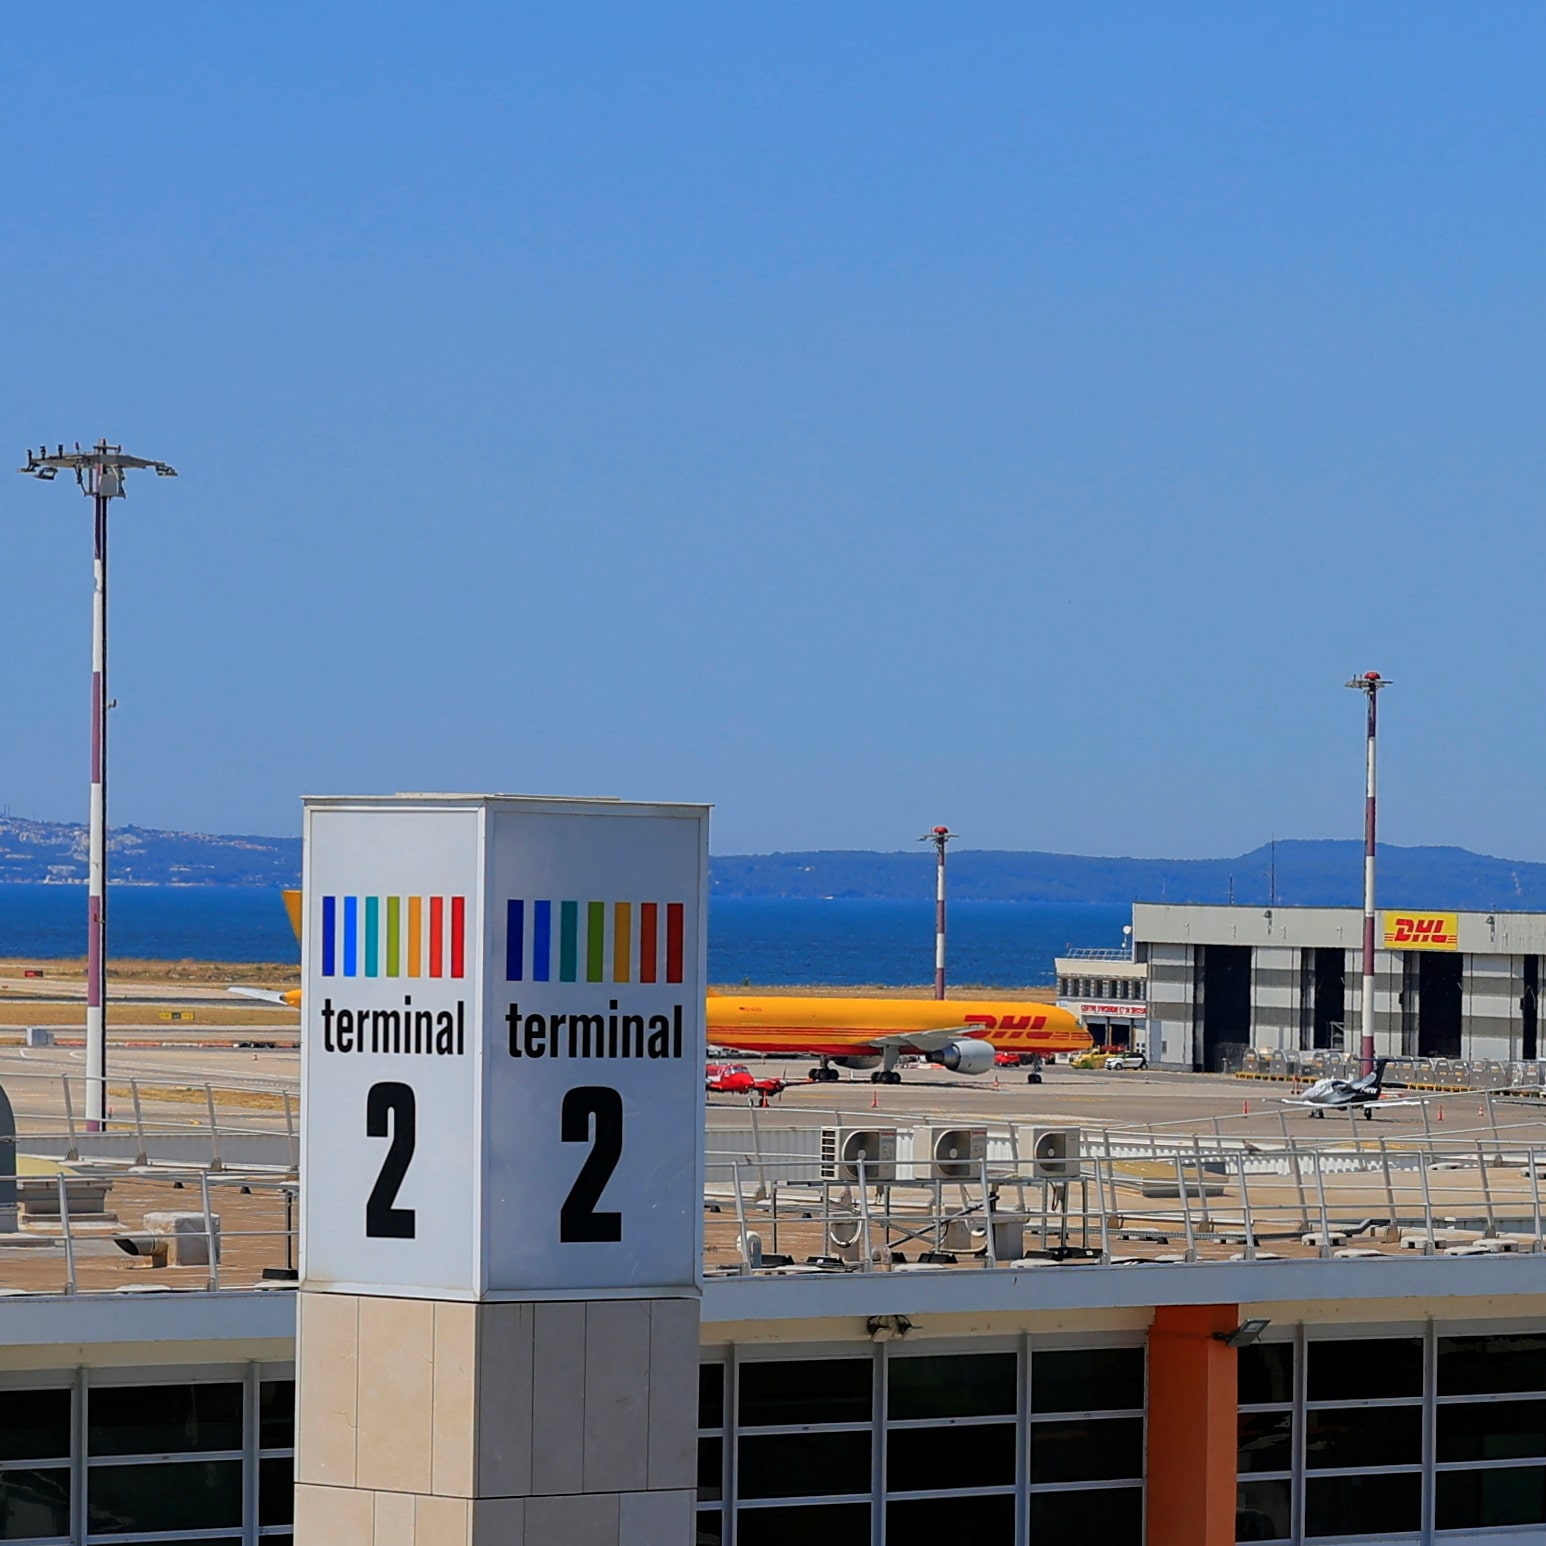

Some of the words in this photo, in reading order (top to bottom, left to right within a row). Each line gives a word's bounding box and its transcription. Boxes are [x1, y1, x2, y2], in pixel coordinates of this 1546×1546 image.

[1394, 918, 1448, 944] DHL
[321, 995, 465, 1056] terminal
[505, 1000, 683, 1059] terminal
[962, 1014, 1053, 1040] DHL
[366, 1081, 416, 1240] 2
[560, 1085, 623, 1243] 2
